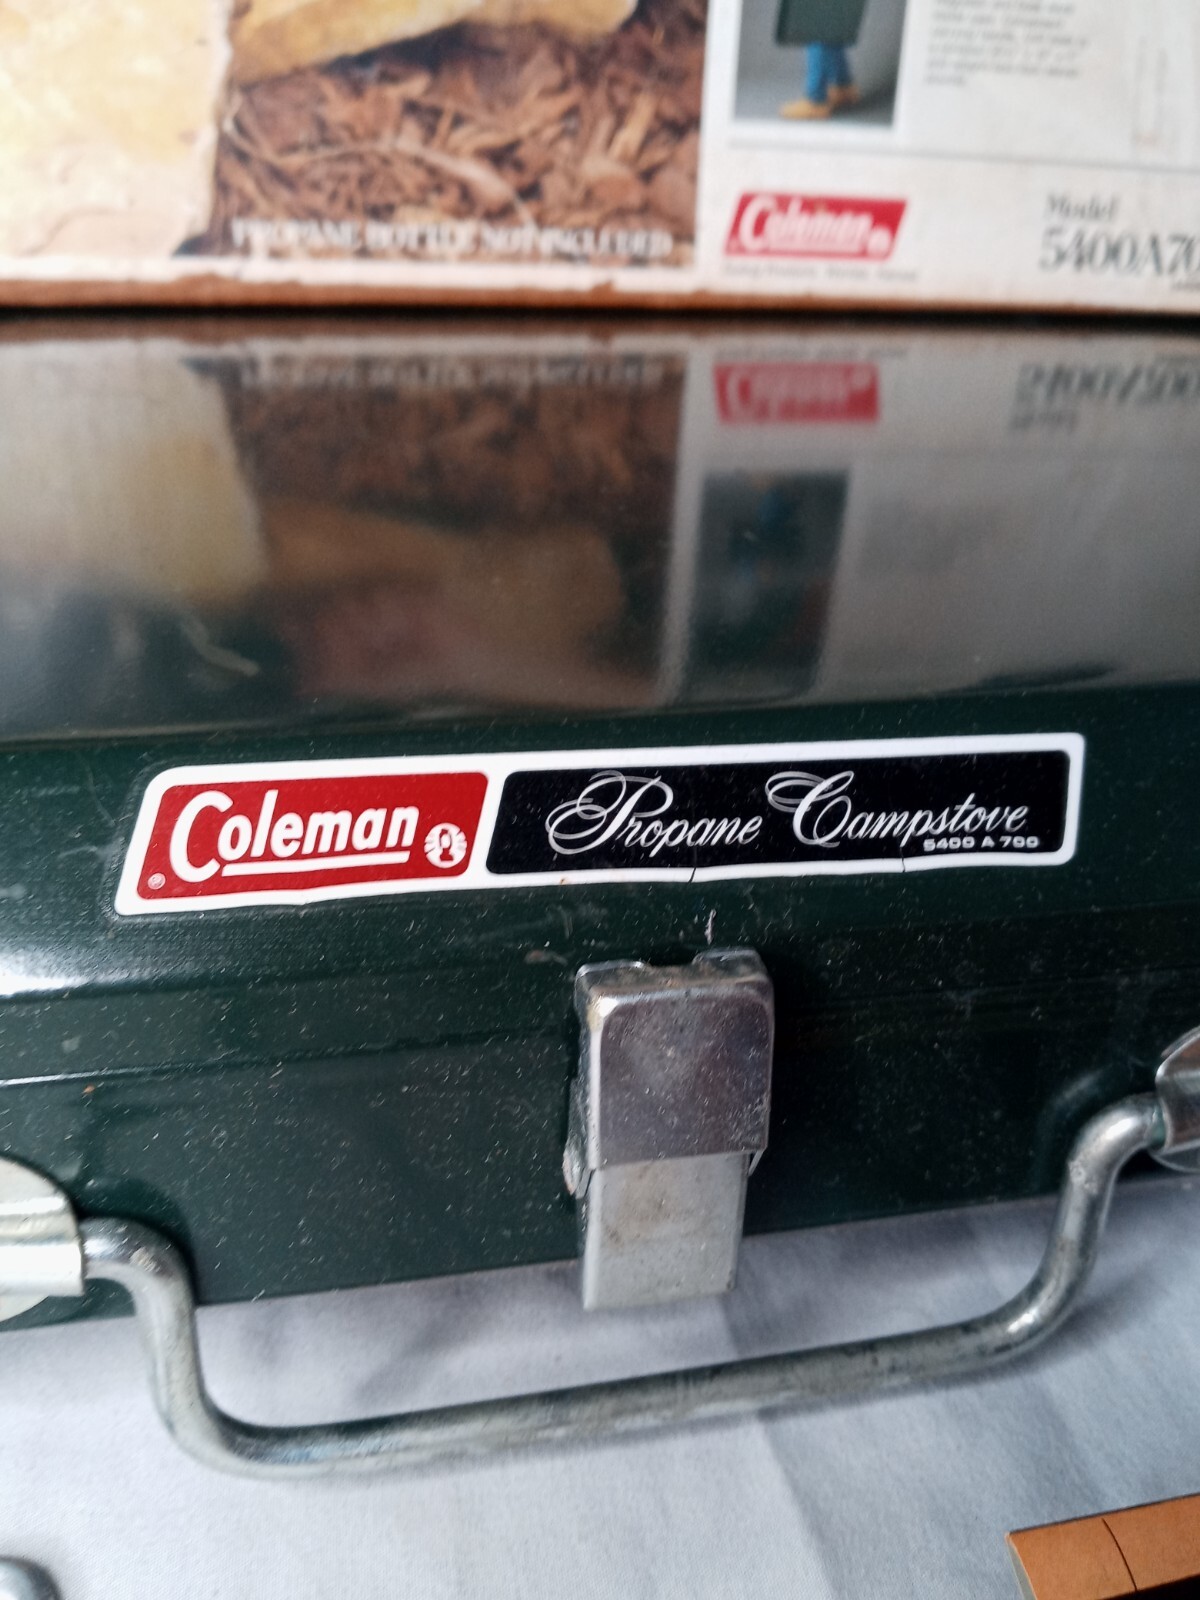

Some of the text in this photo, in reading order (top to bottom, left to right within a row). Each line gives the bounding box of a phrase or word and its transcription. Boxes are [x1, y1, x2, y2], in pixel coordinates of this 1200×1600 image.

[169, 790, 420, 882] Coleman
[545, 770, 1029, 857] Propane Campstove
[923, 835, 1040, 852] 5400 A 700
